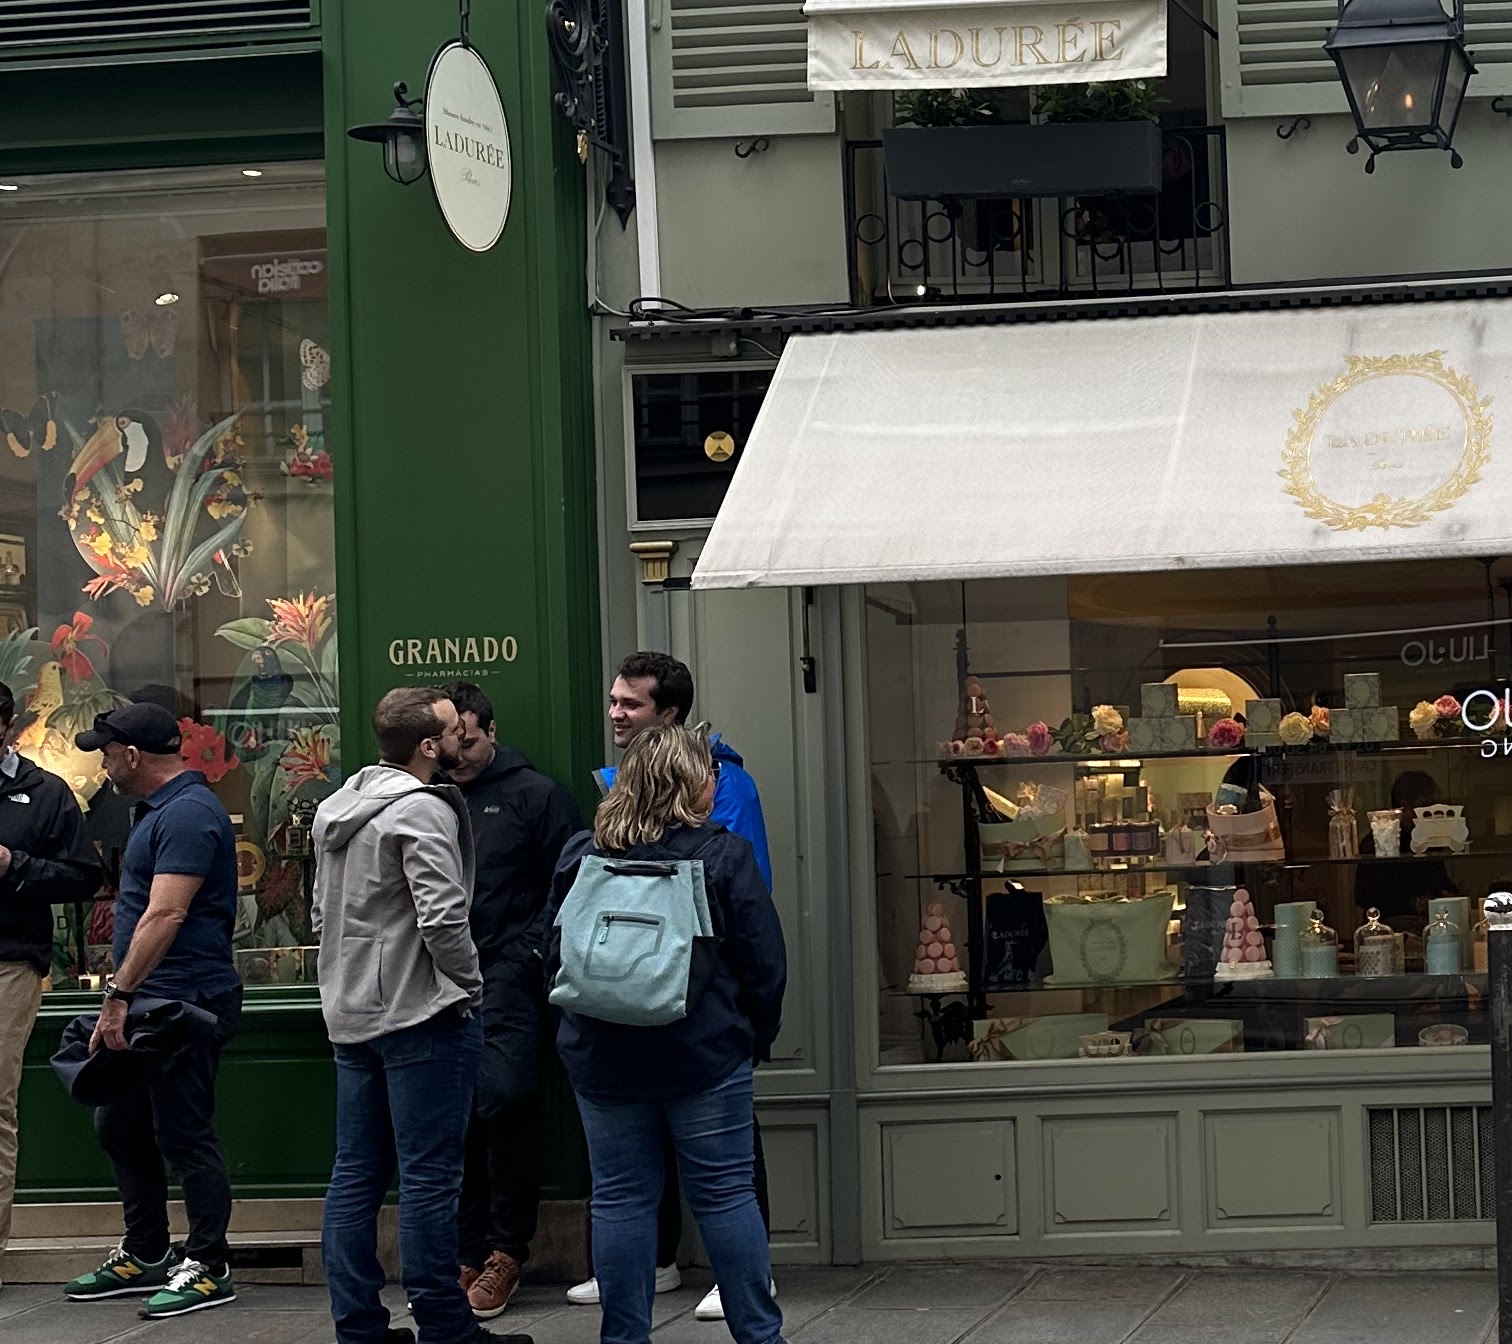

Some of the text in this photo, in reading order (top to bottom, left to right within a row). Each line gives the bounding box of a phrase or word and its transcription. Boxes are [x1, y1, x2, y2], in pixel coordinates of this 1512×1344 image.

[851, 17, 1125, 71] LADURÉE
[434, 124, 505, 170] LADURÉE
[388, 636, 518, 666] GRANADO
